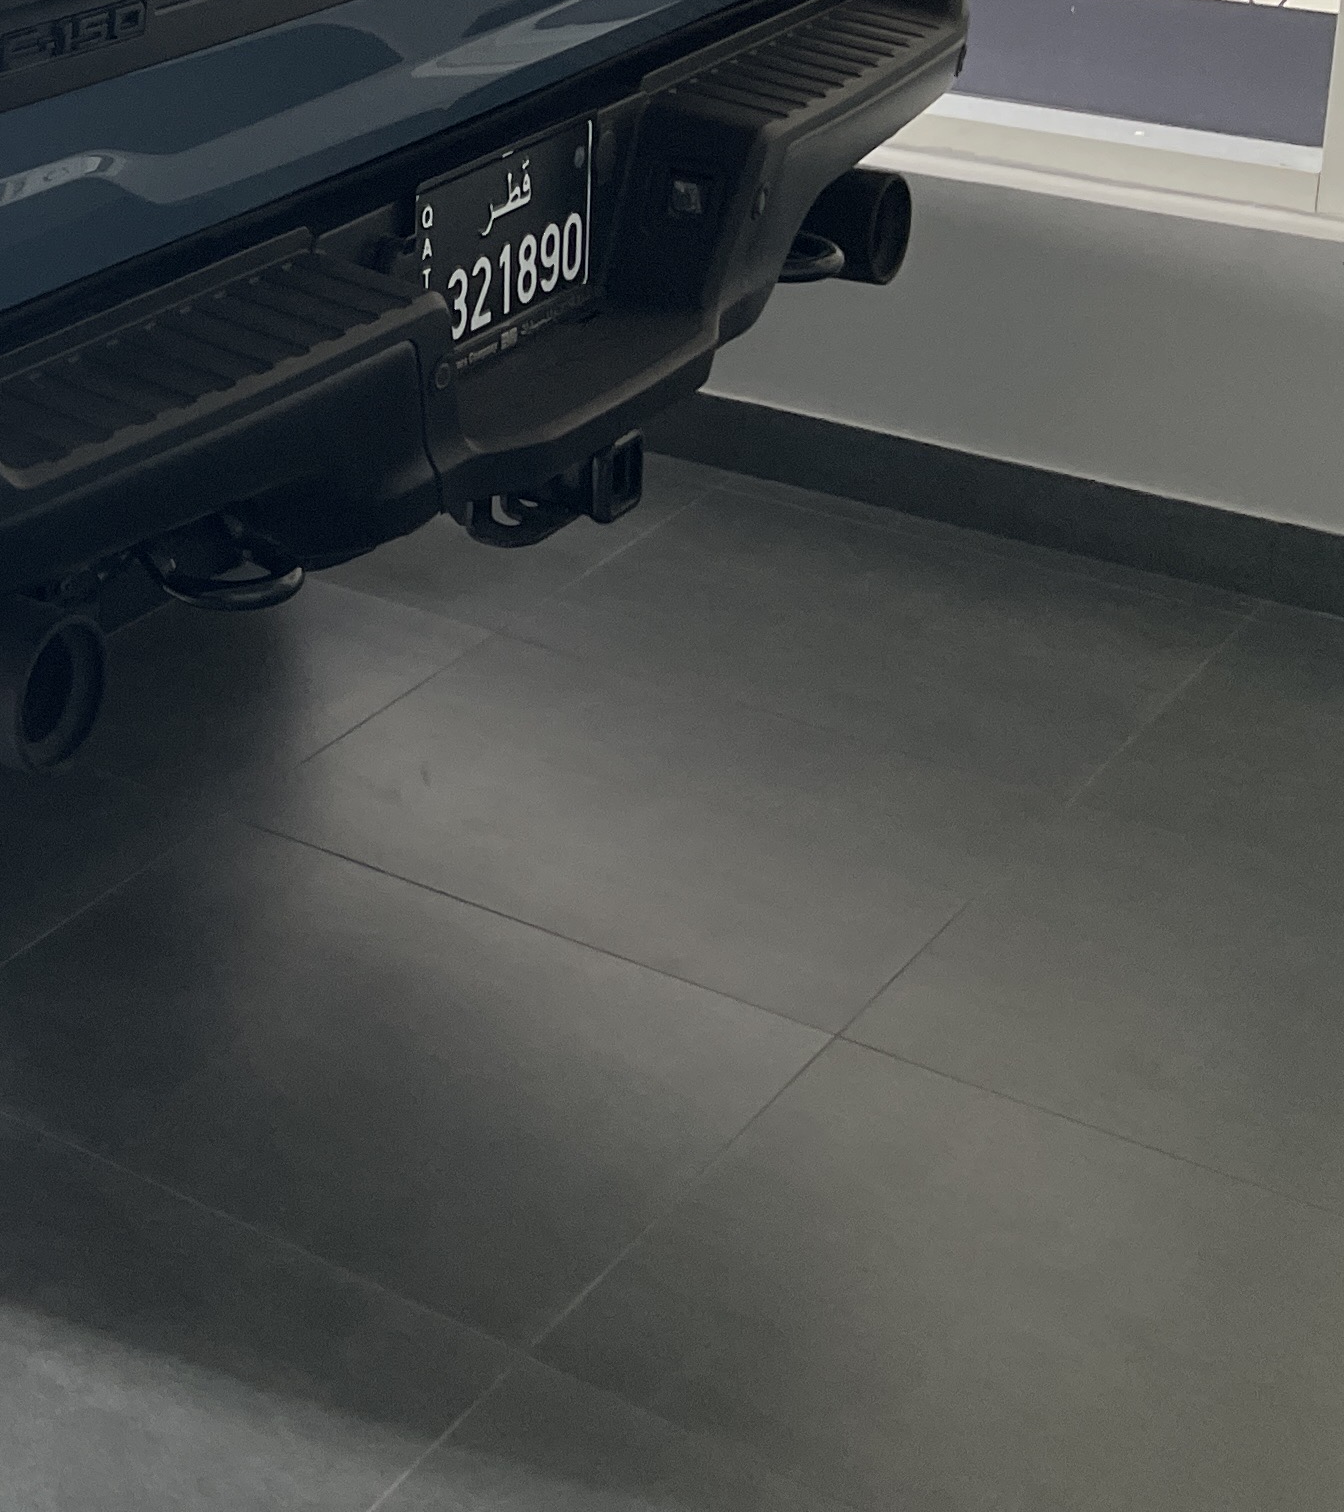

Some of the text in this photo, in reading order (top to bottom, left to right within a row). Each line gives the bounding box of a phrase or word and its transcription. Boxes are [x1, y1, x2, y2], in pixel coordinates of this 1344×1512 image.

[479, 157, 533, 238] قطر
[421, 203, 434, 290] QAT
[447, 211, 584, 341] 321890
